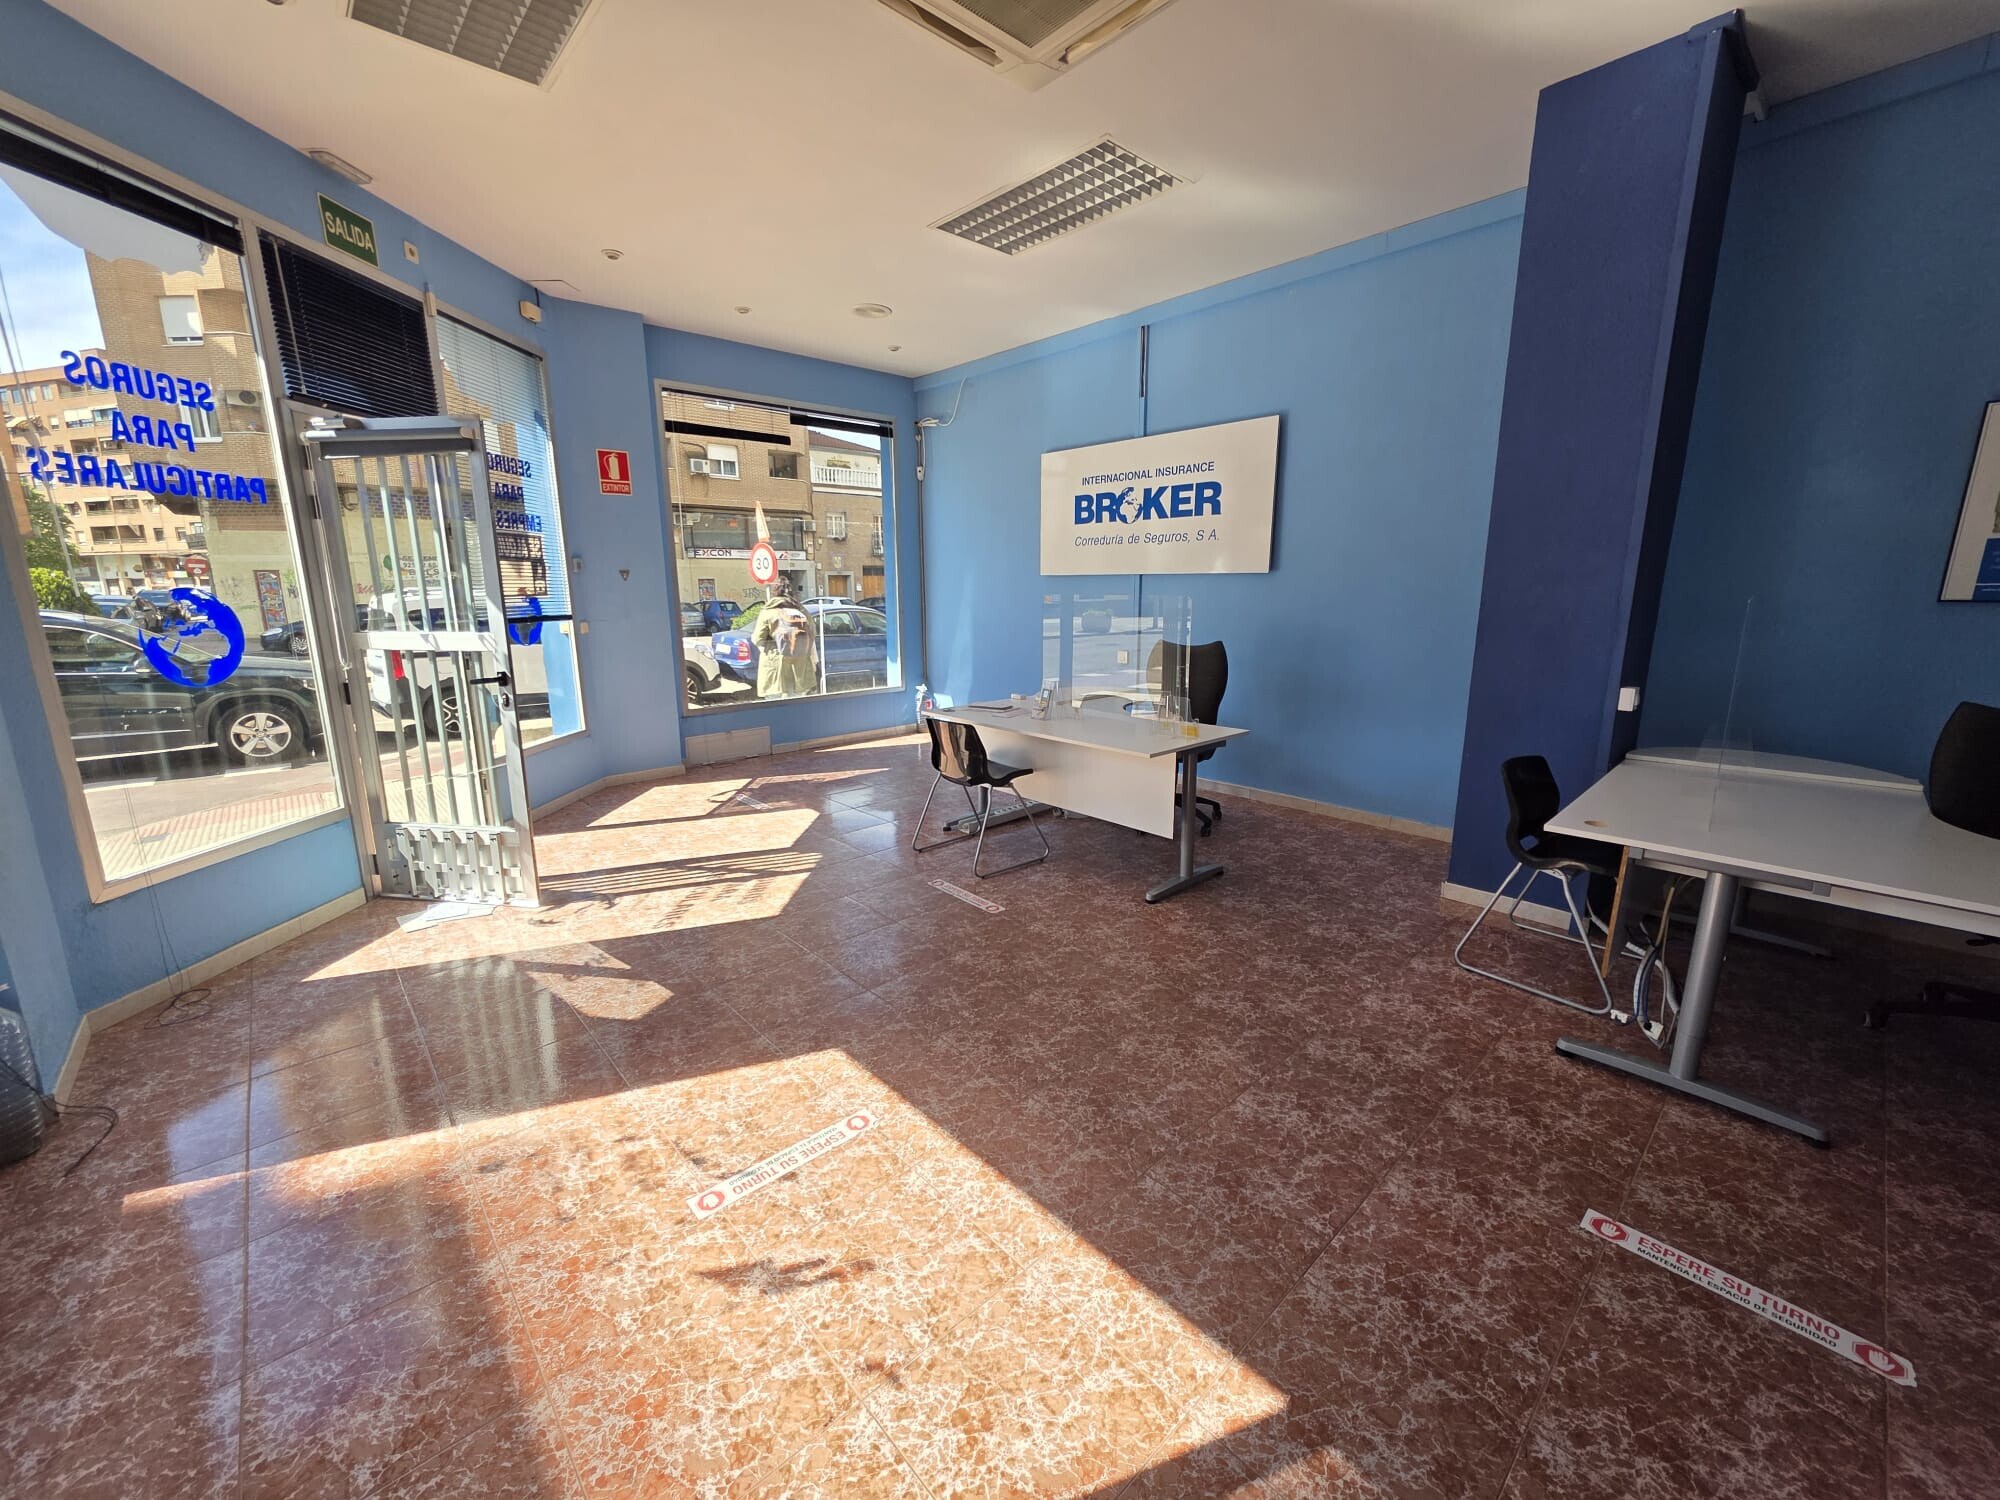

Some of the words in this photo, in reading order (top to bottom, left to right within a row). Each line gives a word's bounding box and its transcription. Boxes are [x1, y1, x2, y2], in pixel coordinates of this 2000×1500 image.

[325, 211, 374, 253] SALIDA
[1082, 471, 1153, 486] INTERNACIONAL
[1155, 461, 1215, 477] INSURANCE
[1074, 481, 1222, 525] BROKER
[1074, 533, 1123, 546] Correduría
[1127, 533, 1140, 544] de
[756, 557, 770, 570] 30
[799, 1131, 846, 1158] ESPERE
[780, 1156, 798, 1169] SU
[732, 1167, 779, 1194] TURNO
[1637, 1247, 1690, 1276] MANTENGA
[1692, 1274, 1704, 1283] EL
[1707, 1280, 1750, 1305] ESPACIO
[1753, 1303, 1768, 1314] DE
[1771, 1312, 1837, 1348] SEGURIDAD
[1638, 1236, 1716, 1280] ESPERE
[1721, 1277, 1751, 1297] SU
[1759, 1292, 1840, 1340] TURNO
